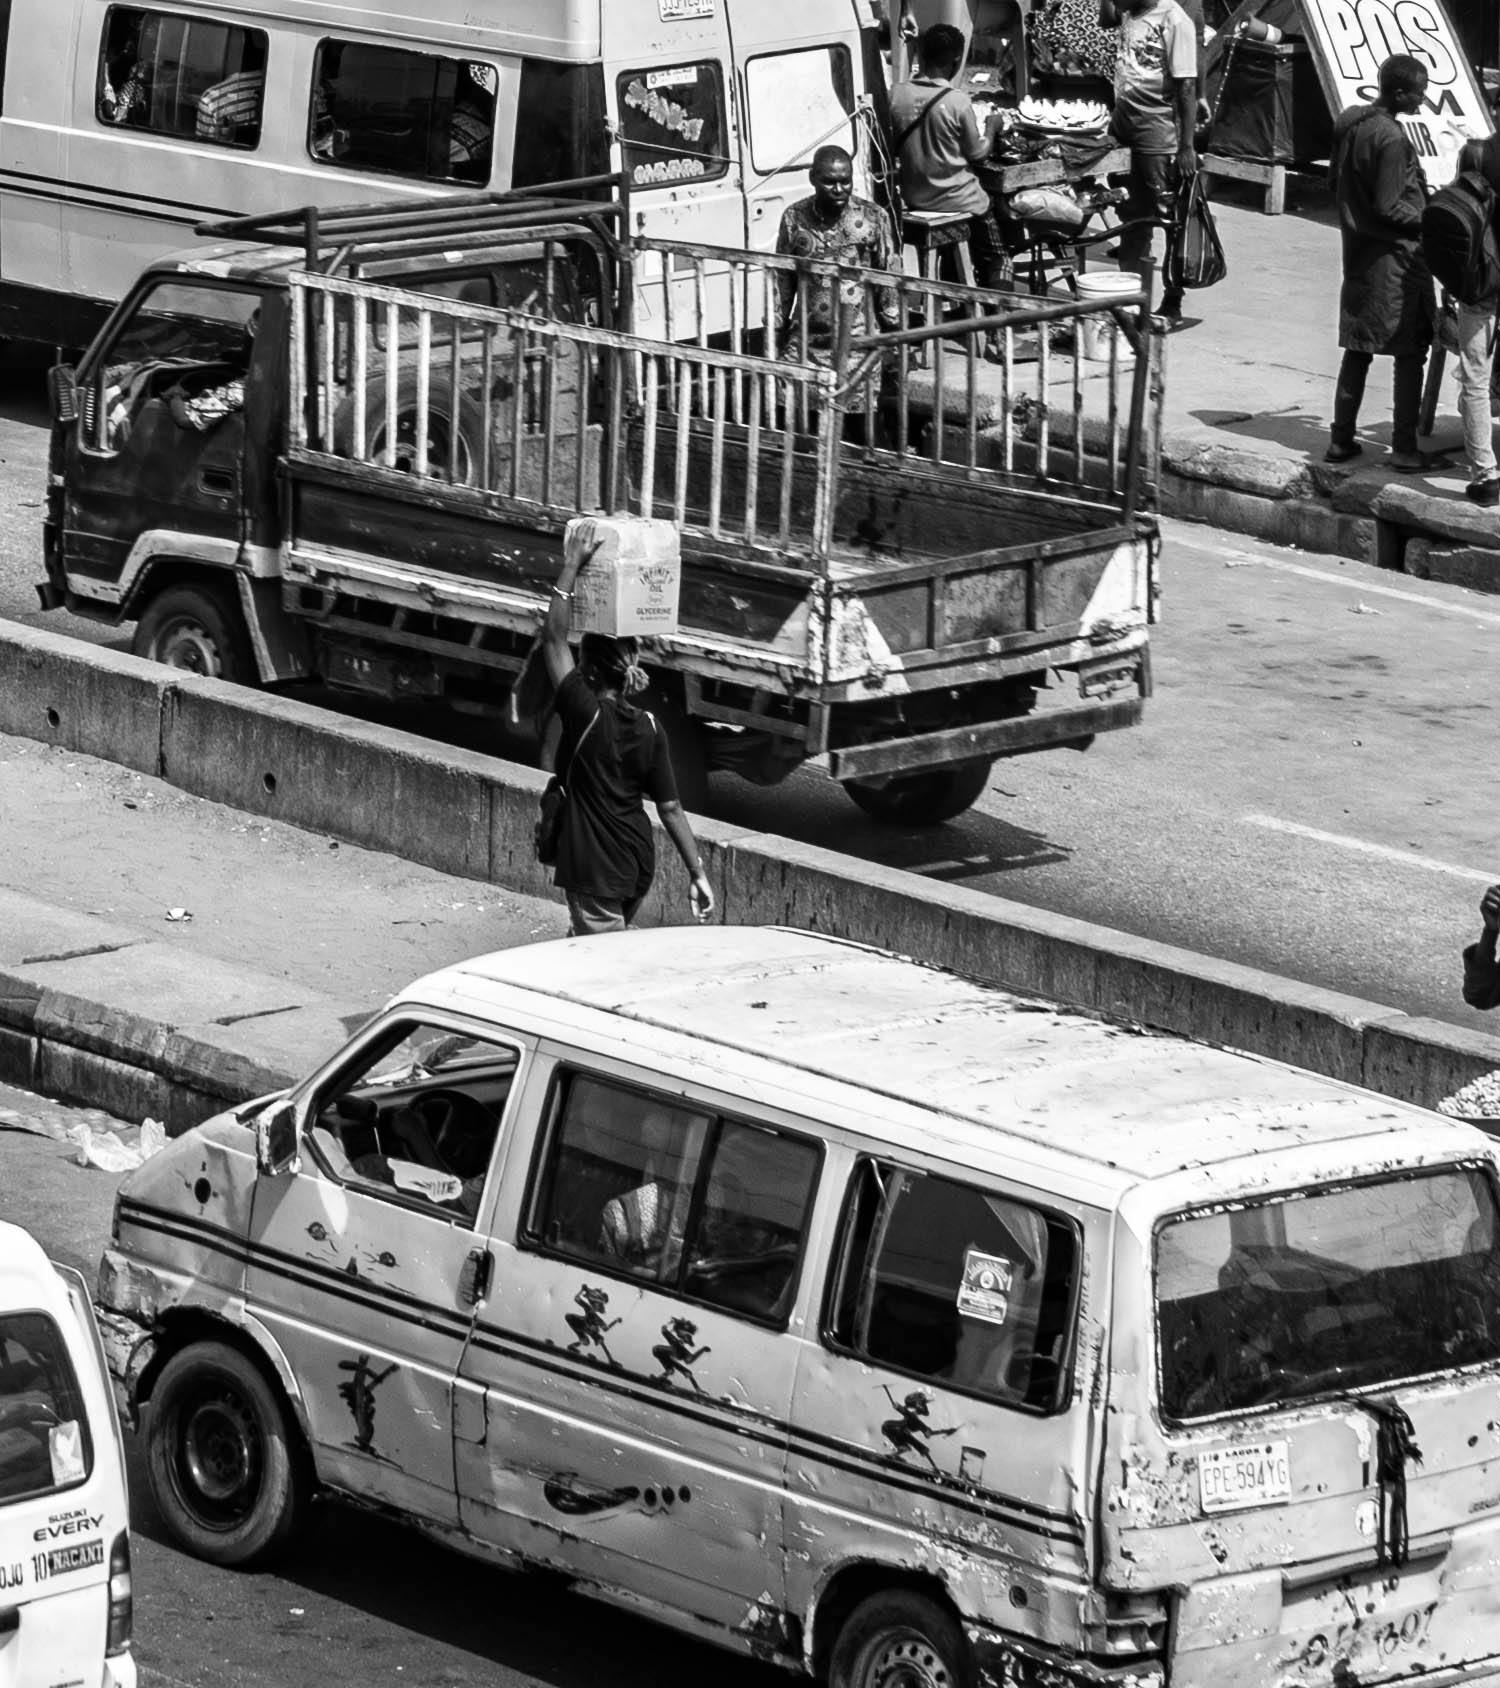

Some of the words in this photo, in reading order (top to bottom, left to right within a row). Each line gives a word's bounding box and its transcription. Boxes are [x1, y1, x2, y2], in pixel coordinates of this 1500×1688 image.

[1226, 1447, 1262, 1458] LAGOS
[1205, 1459, 1287, 1496] EPE-594YG
[33, 1514, 104, 1542] EVERY
[48, 1508, 88, 1524] SUZUKI
[32, 1553, 47, 1584] 10
[52, 1541, 103, 1570] NACANT
